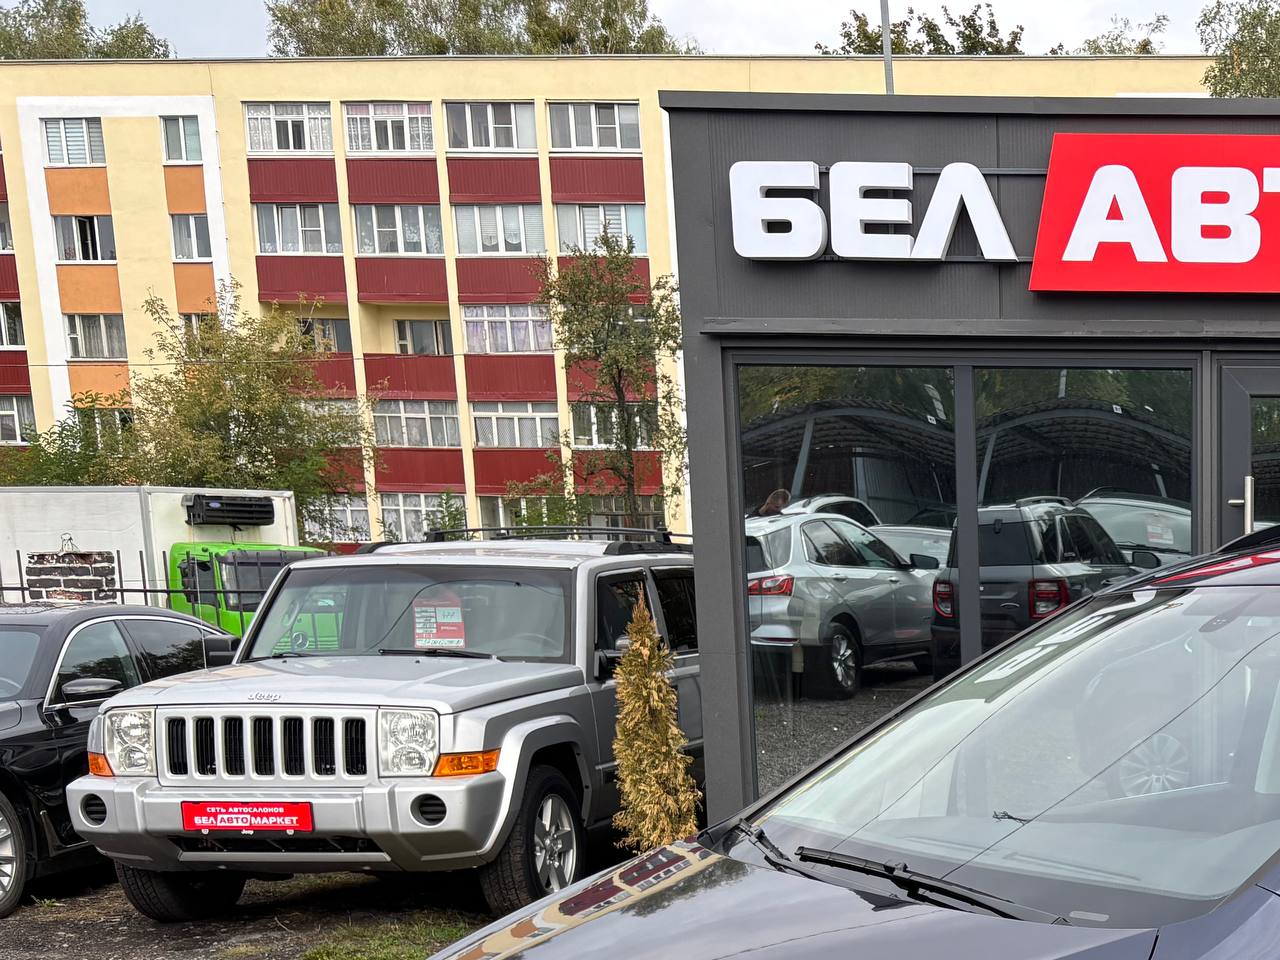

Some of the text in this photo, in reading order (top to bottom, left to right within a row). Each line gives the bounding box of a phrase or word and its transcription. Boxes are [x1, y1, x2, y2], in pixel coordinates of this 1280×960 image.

[729, 160, 1020, 263] БЕЛ
[194, 816, 299, 825] БЕЛ АВТО МАРКЕТ
